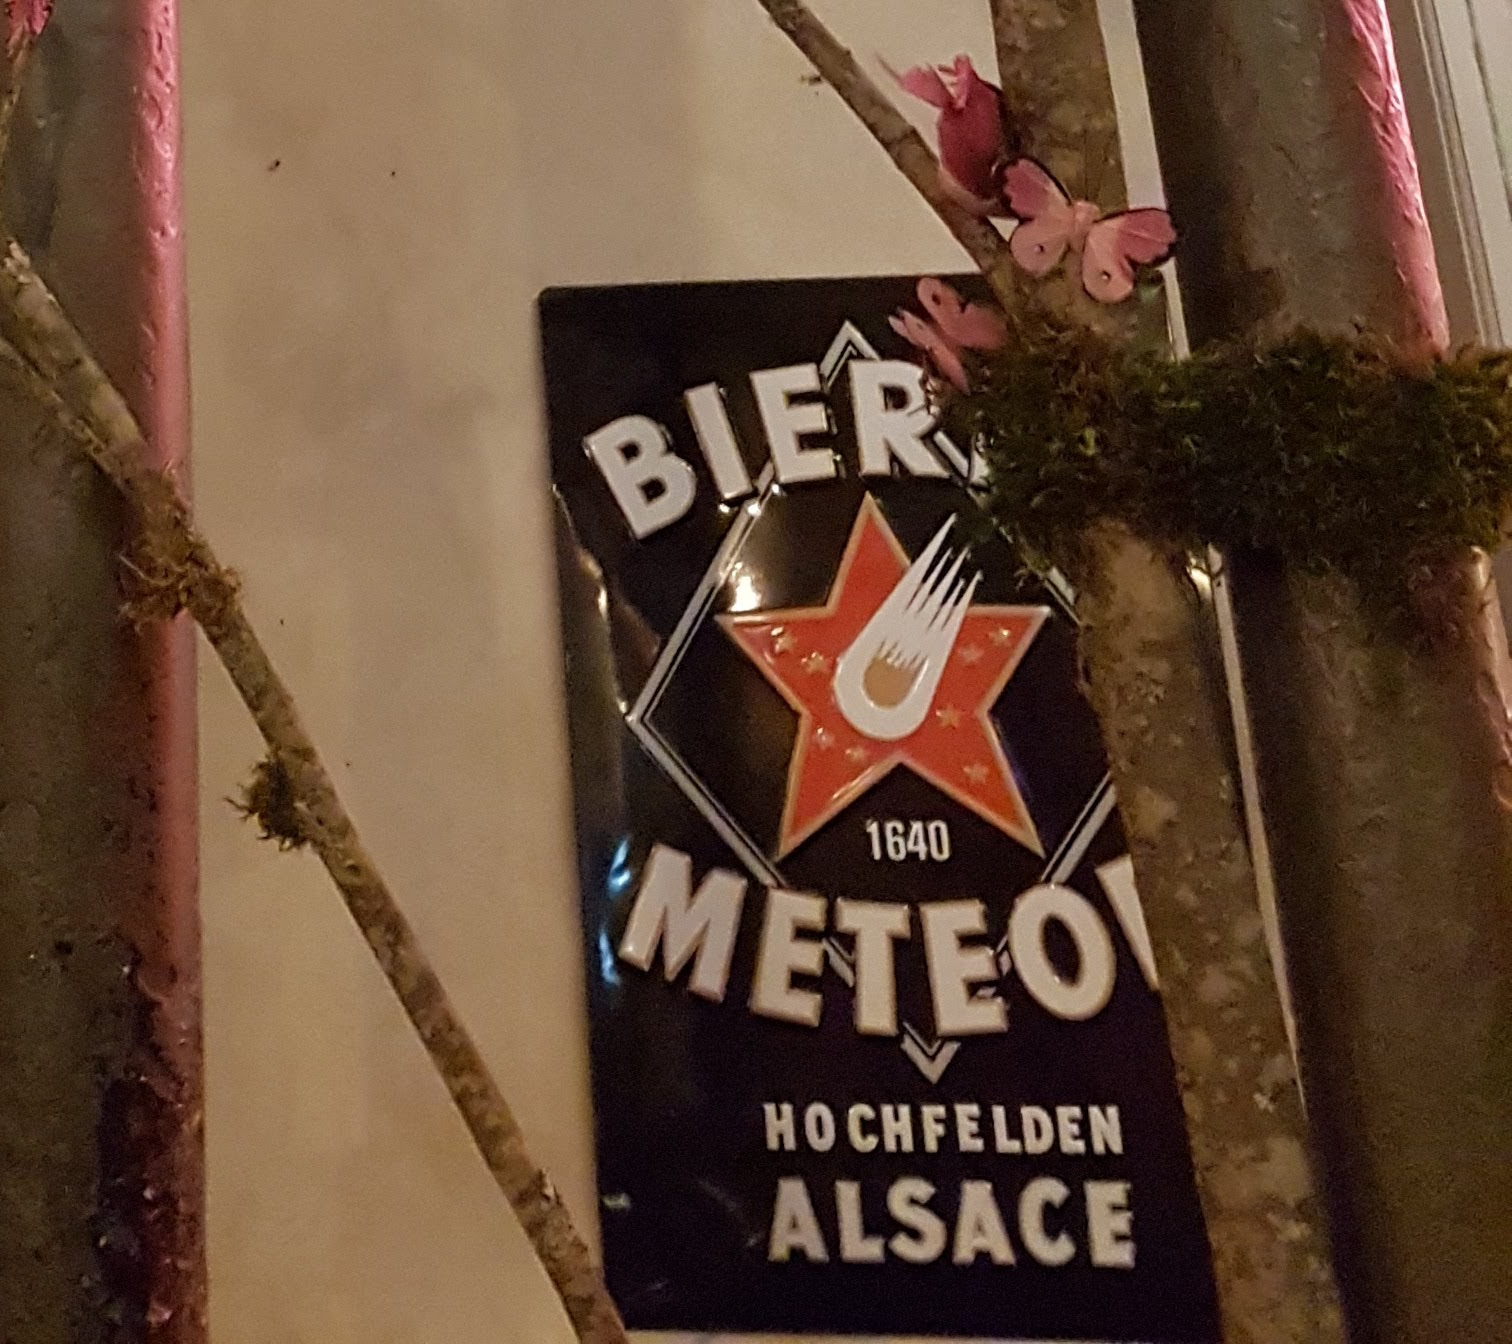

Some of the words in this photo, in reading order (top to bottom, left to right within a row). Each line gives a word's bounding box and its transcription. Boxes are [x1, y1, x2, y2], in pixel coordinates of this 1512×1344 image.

[584, 360, 968, 540] BIER
[864, 818, 952, 862] 1640
[763, 1102, 1126, 1156] HOCHFELDEN
[768, 1177, 1138, 1271] ALSACE
